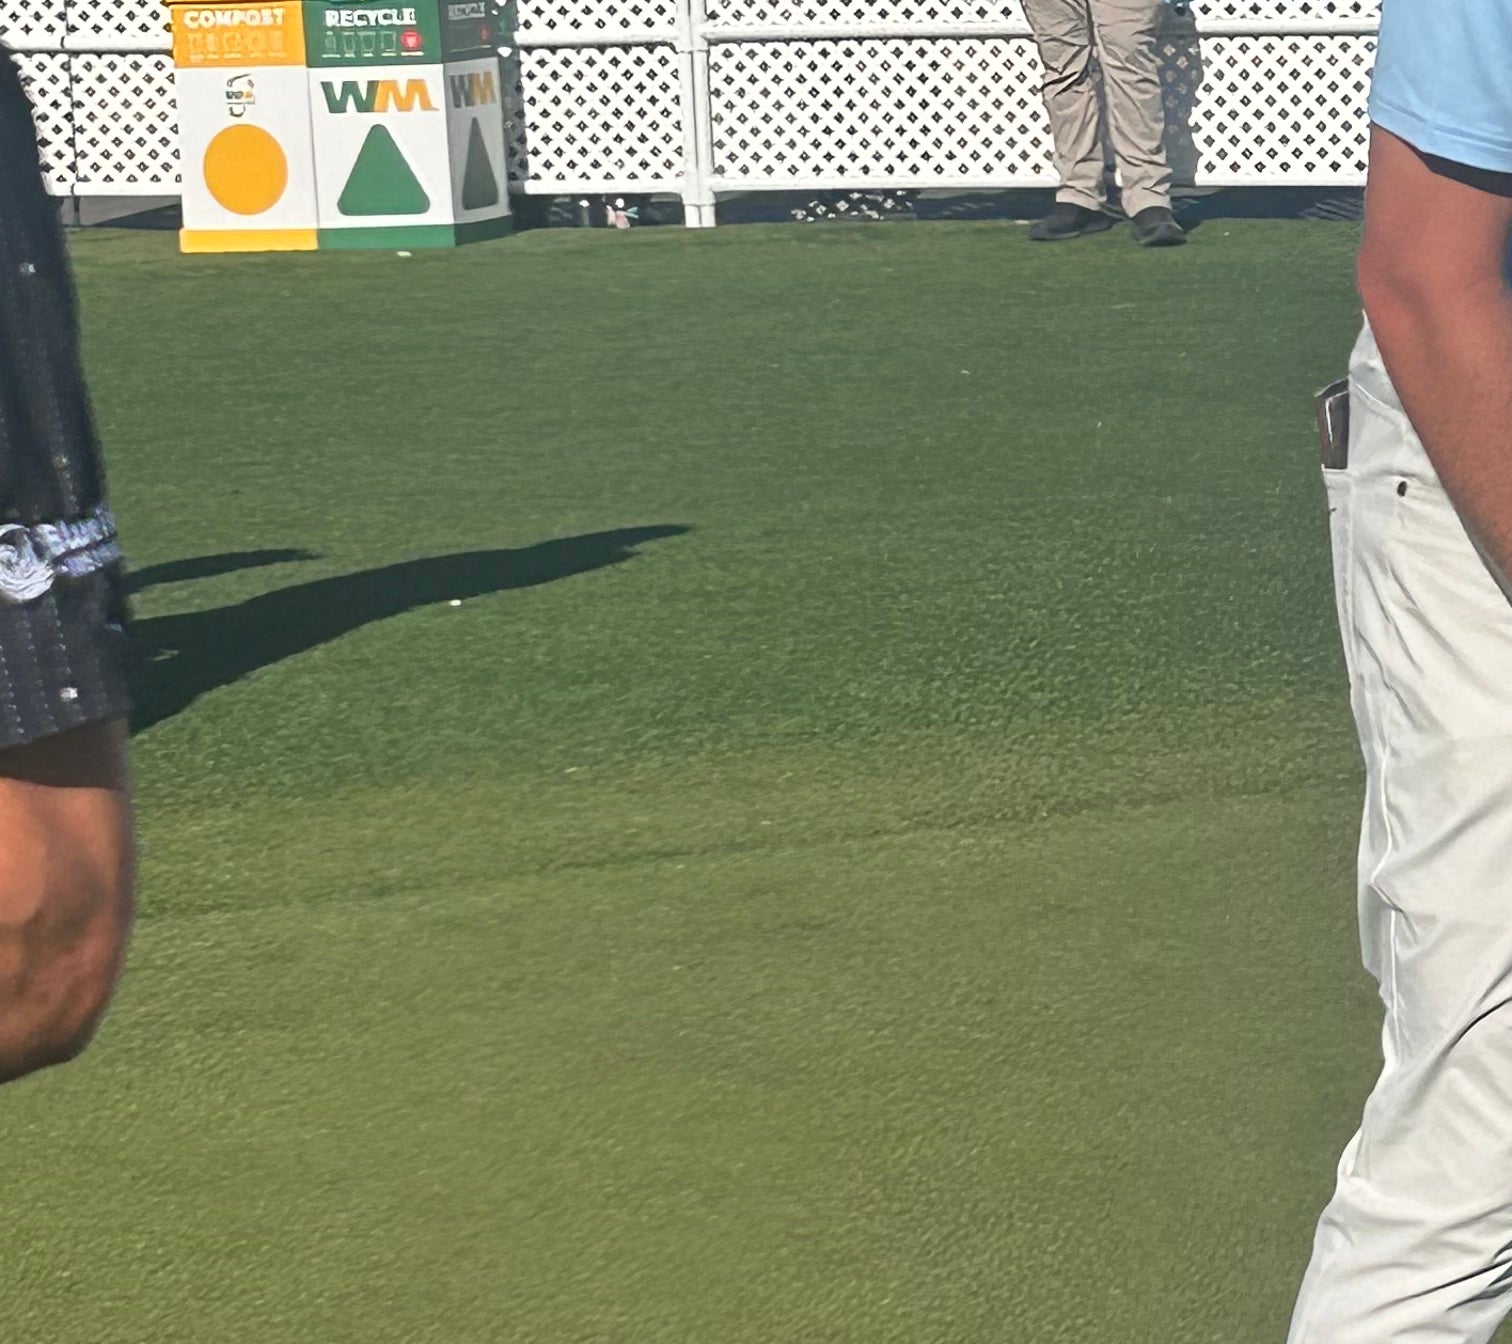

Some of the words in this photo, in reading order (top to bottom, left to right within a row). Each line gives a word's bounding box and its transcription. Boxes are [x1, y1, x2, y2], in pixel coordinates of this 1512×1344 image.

[184, 8, 285, 29] COMPOST
[325, 8, 417, 27] RECYCLE
[320, 79, 440, 114] WM
[449, 71, 498, 109] WM
